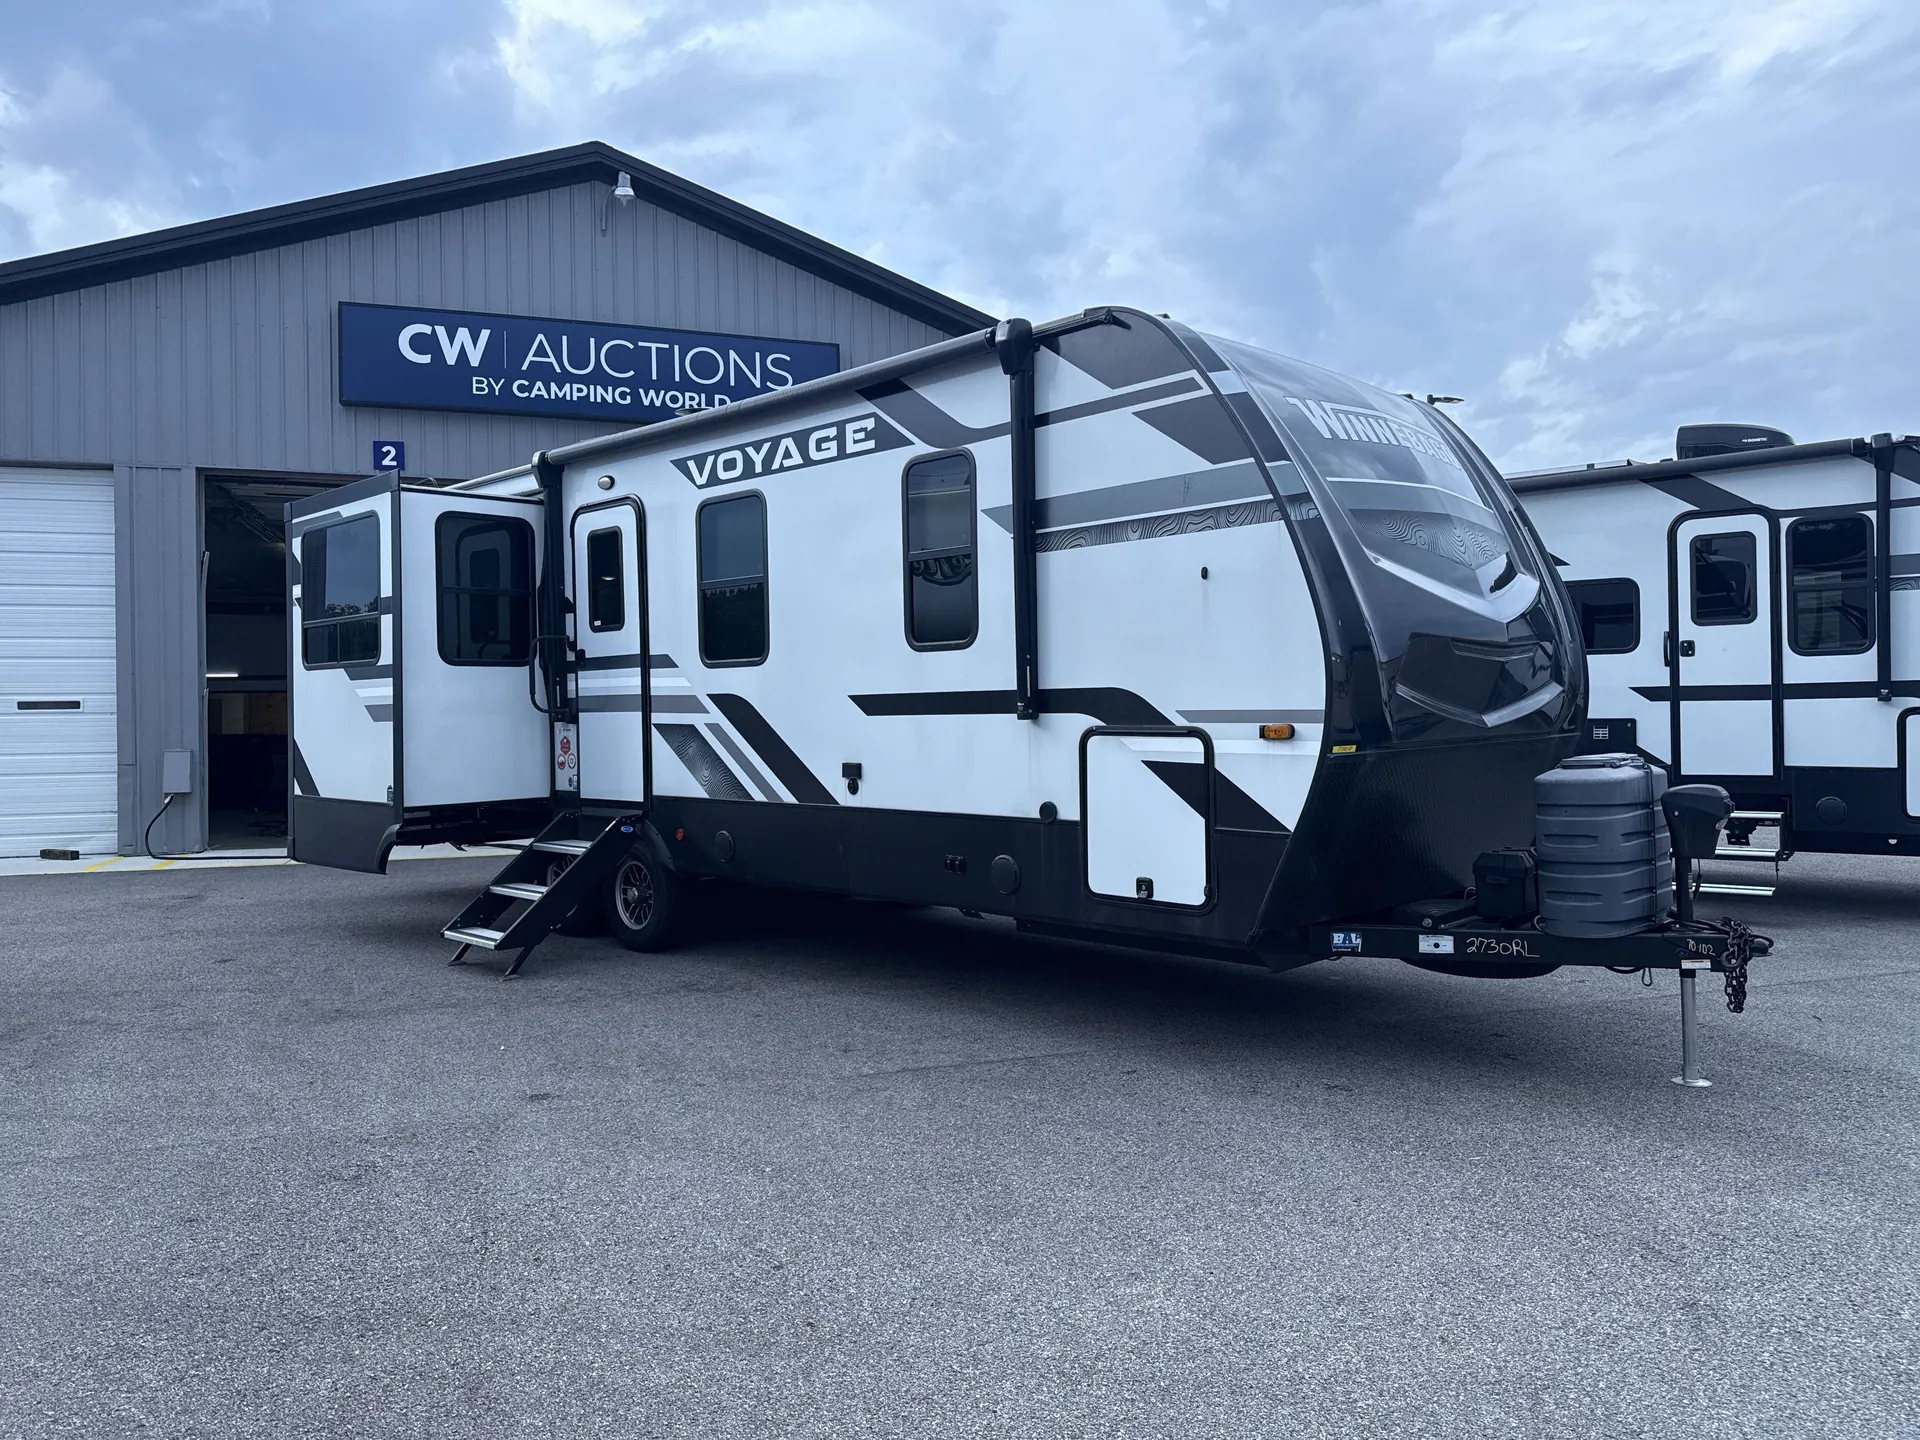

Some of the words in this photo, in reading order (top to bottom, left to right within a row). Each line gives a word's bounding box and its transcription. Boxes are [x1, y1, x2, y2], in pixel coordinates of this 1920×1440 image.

[398, 323, 491, 367] CW
[520, 332, 794, 391] AUCTIONS
[472, 376, 505, 396] BY
[512, 379, 632, 406] CAMPING
[638, 388, 731, 410] WORLD
[381, 445, 397, 466] 2
[687, 417, 875, 486] VOYAGE
[1466, 938, 1540, 957] 2730RL
